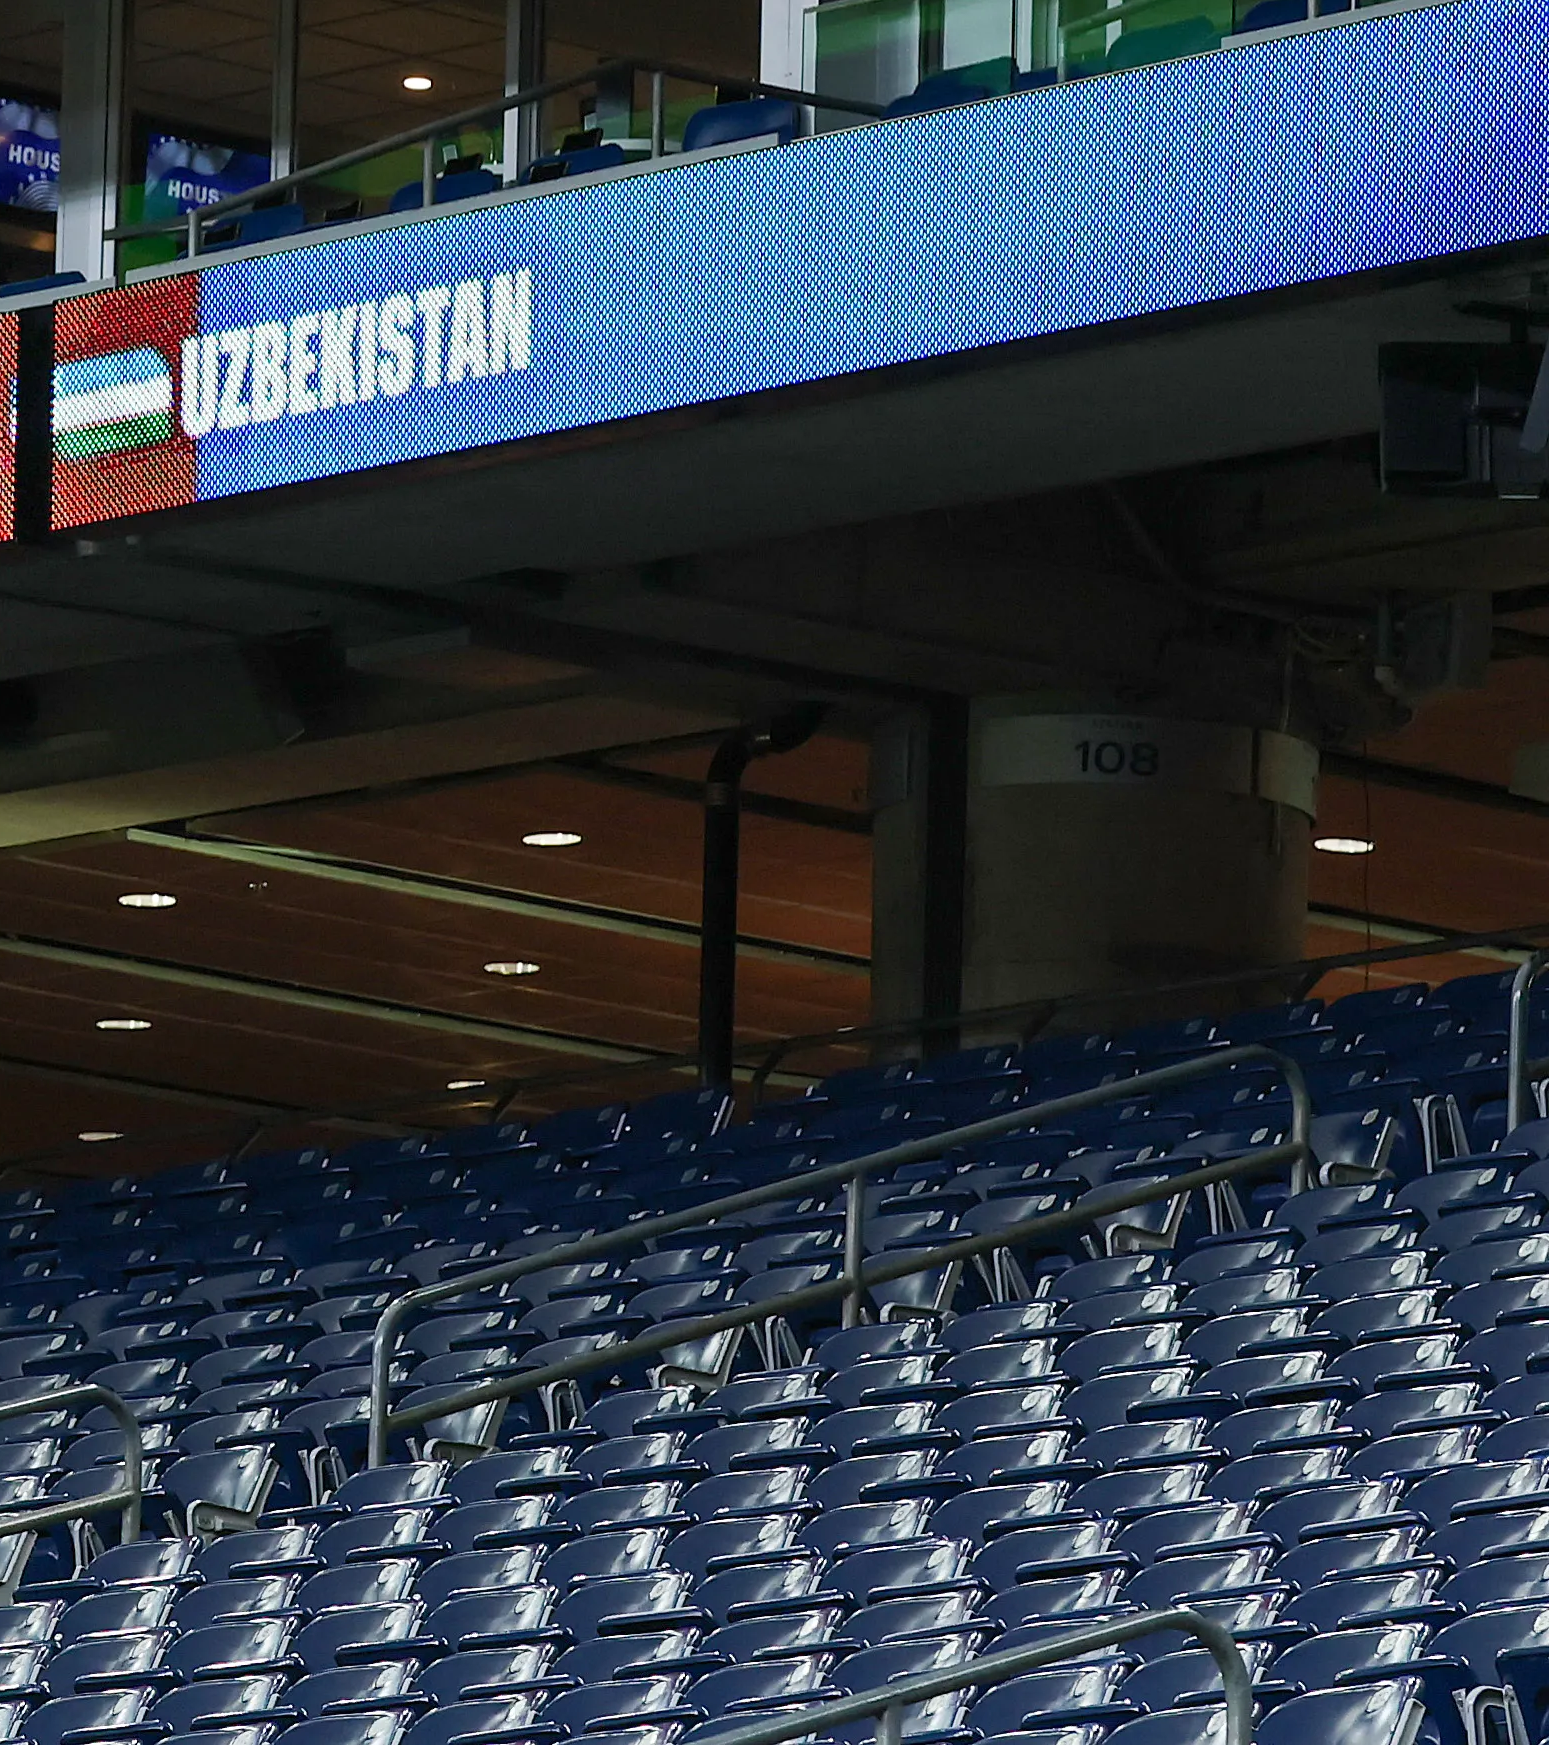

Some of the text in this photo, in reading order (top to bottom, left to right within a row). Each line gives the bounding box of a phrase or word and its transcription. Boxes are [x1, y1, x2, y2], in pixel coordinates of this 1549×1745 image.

[8, 143, 61, 173] HOUS
[167, 178, 227, 205] HOUS
[179, 265, 533, 439] UZBEKISTAN
[1074, 740, 1160, 776] 108
